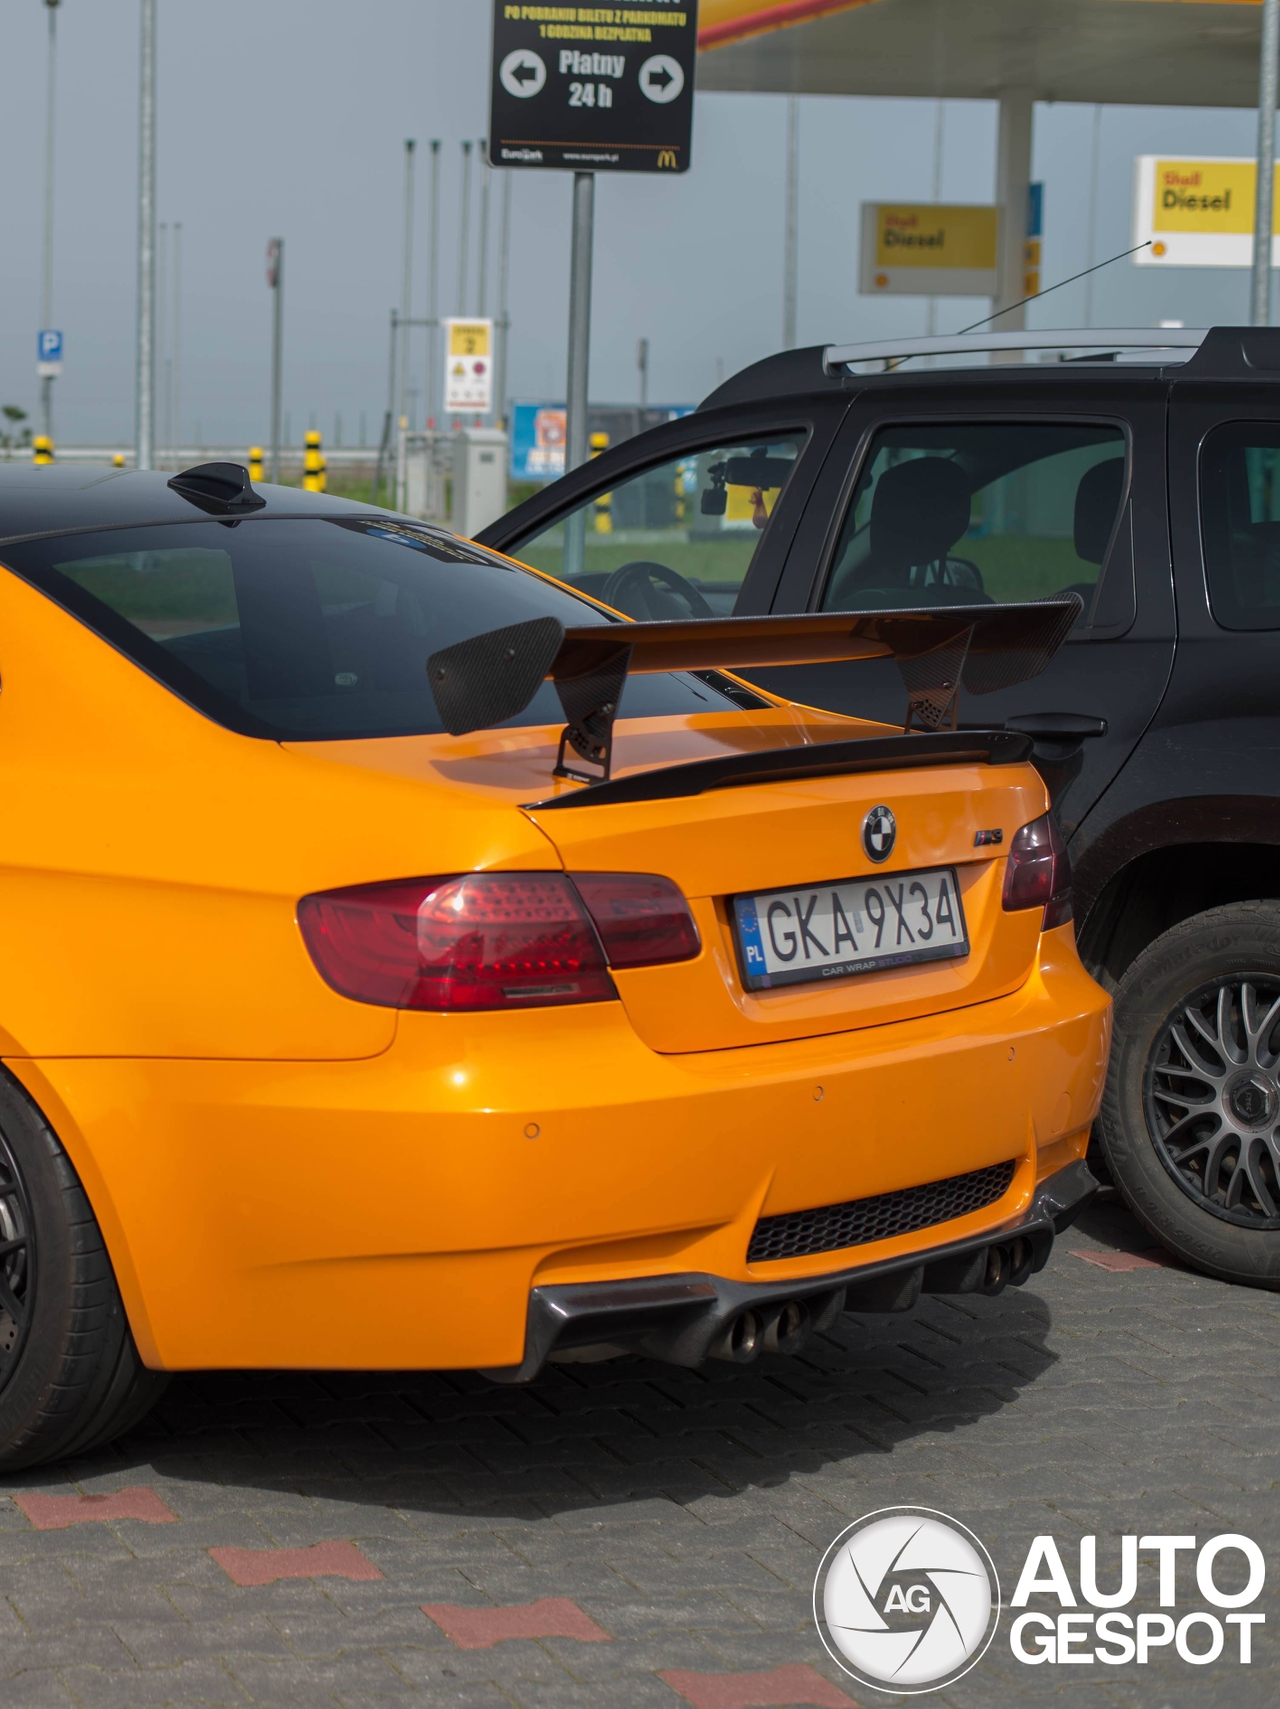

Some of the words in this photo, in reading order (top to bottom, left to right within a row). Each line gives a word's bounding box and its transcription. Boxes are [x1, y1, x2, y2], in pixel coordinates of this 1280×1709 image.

[504, 5, 520, 20] PO
[521, 6, 576, 22] POBRANIU
[577, 8, 614, 24] BILETU
[614, 10, 622, 24] Z
[622, 10, 687, 27] PARKOMATU
[539, 24, 546, 38] 1
[546, 24, 594, 41] GODZINA
[594, 26, 652, 42] BEZPŁATNA
[558, 49, 625, 78] Płatny
[568, 82, 595, 108] 24
[597, 83, 613, 108] h
[1163, 170, 1202, 186] Shell
[1163, 188, 1231, 211] Diesel
[883, 227, 945, 249] Diesel
[43, 332, 59, 355] P
[767, 891, 860, 962] GKA
[864, 878, 958, 949] 9X34
[746, 945, 764, 963] PL
[1154, 933, 1241, 976] Matador
[822, 966, 844, 977] CAR
[846, 960, 876, 972] WRAP
[878, 955, 912, 967] STUDIO
